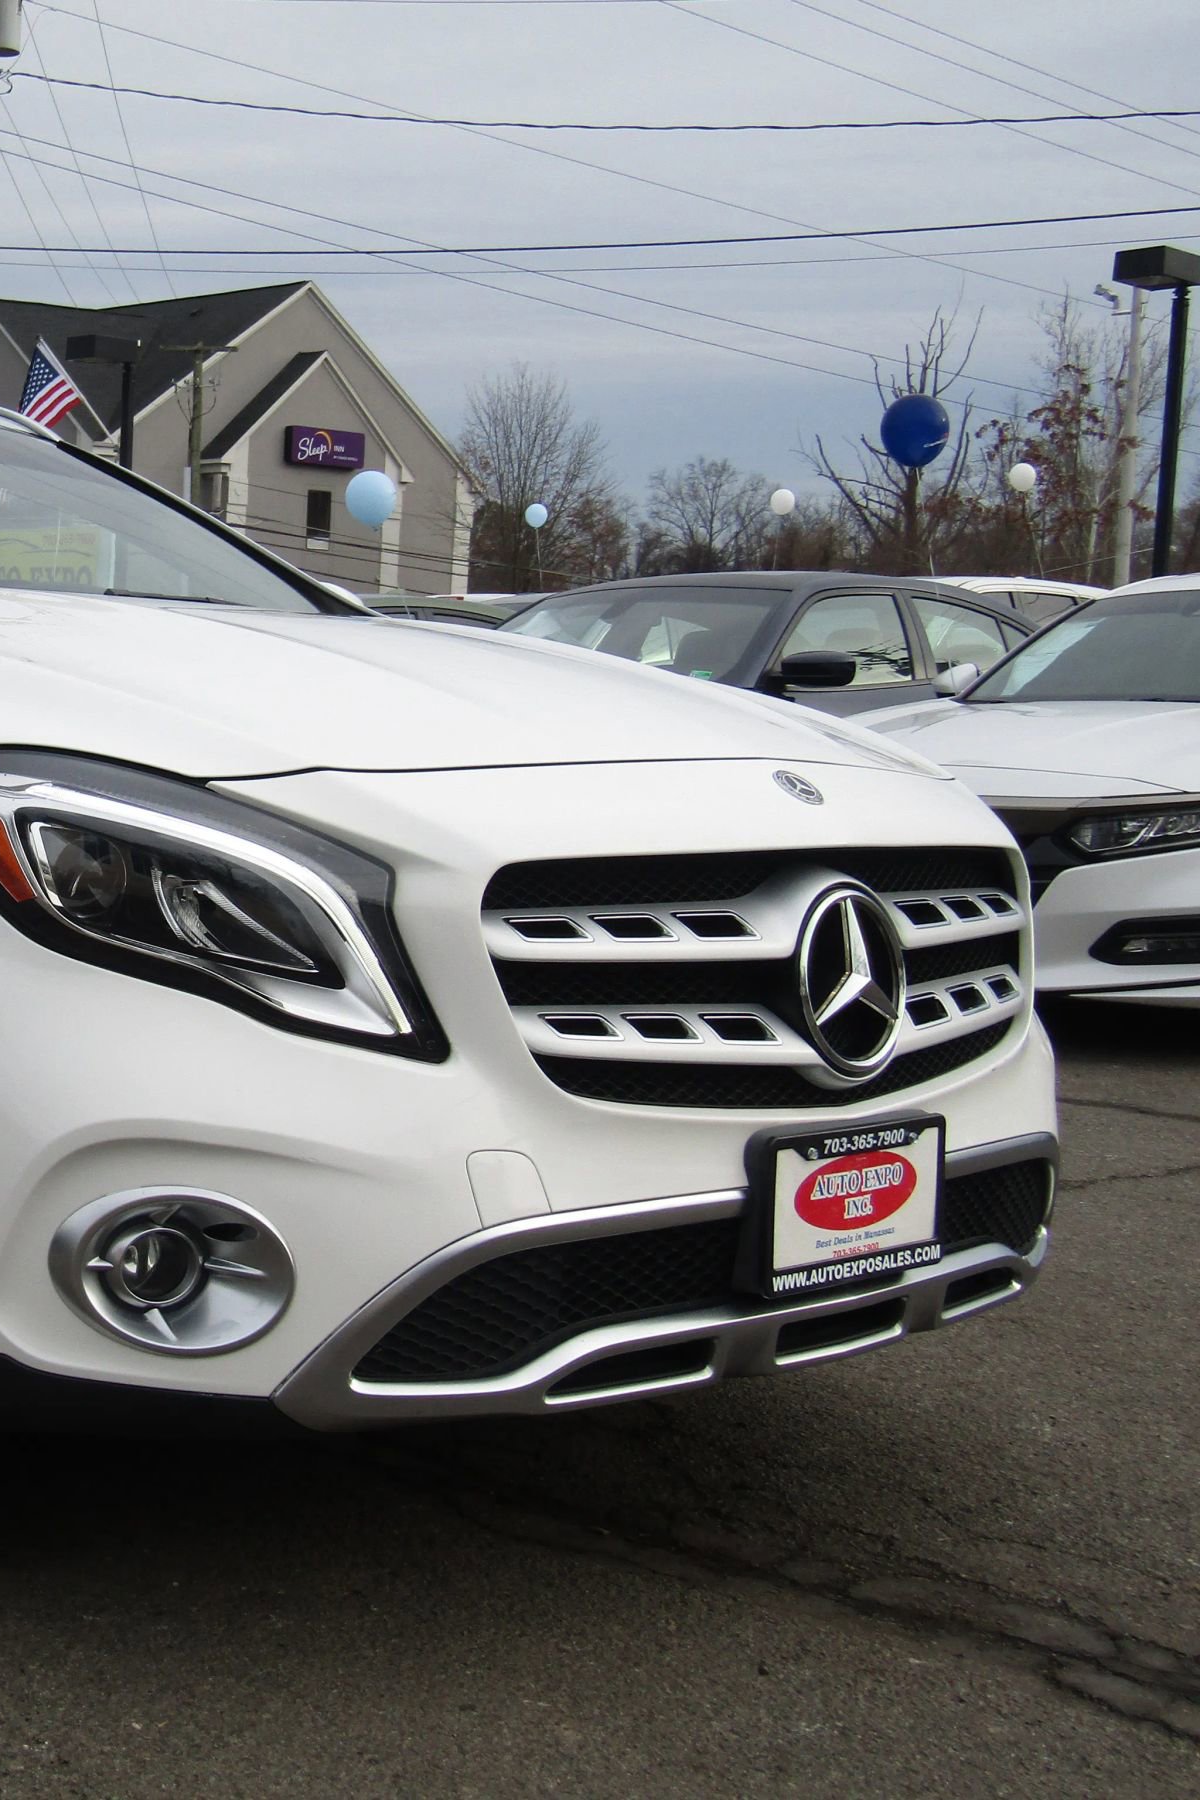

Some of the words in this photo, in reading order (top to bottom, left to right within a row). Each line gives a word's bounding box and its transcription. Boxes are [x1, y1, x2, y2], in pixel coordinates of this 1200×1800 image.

[297, 437, 328, 461] Sleep
[823, 1128, 905, 1155] 703-365-7900
[810, 1170, 861, 1200] AUTO
[862, 1162, 904, 1191] EXPO
[844, 1194, 873, 1219] INC.
[816, 1240, 832, 1249] Best
[834, 1234, 854, 1246] Deals
[855, 1233, 862, 1241] in
[772, 1244, 941, 1293] WWW.AUTOEXPOSALES.COM
